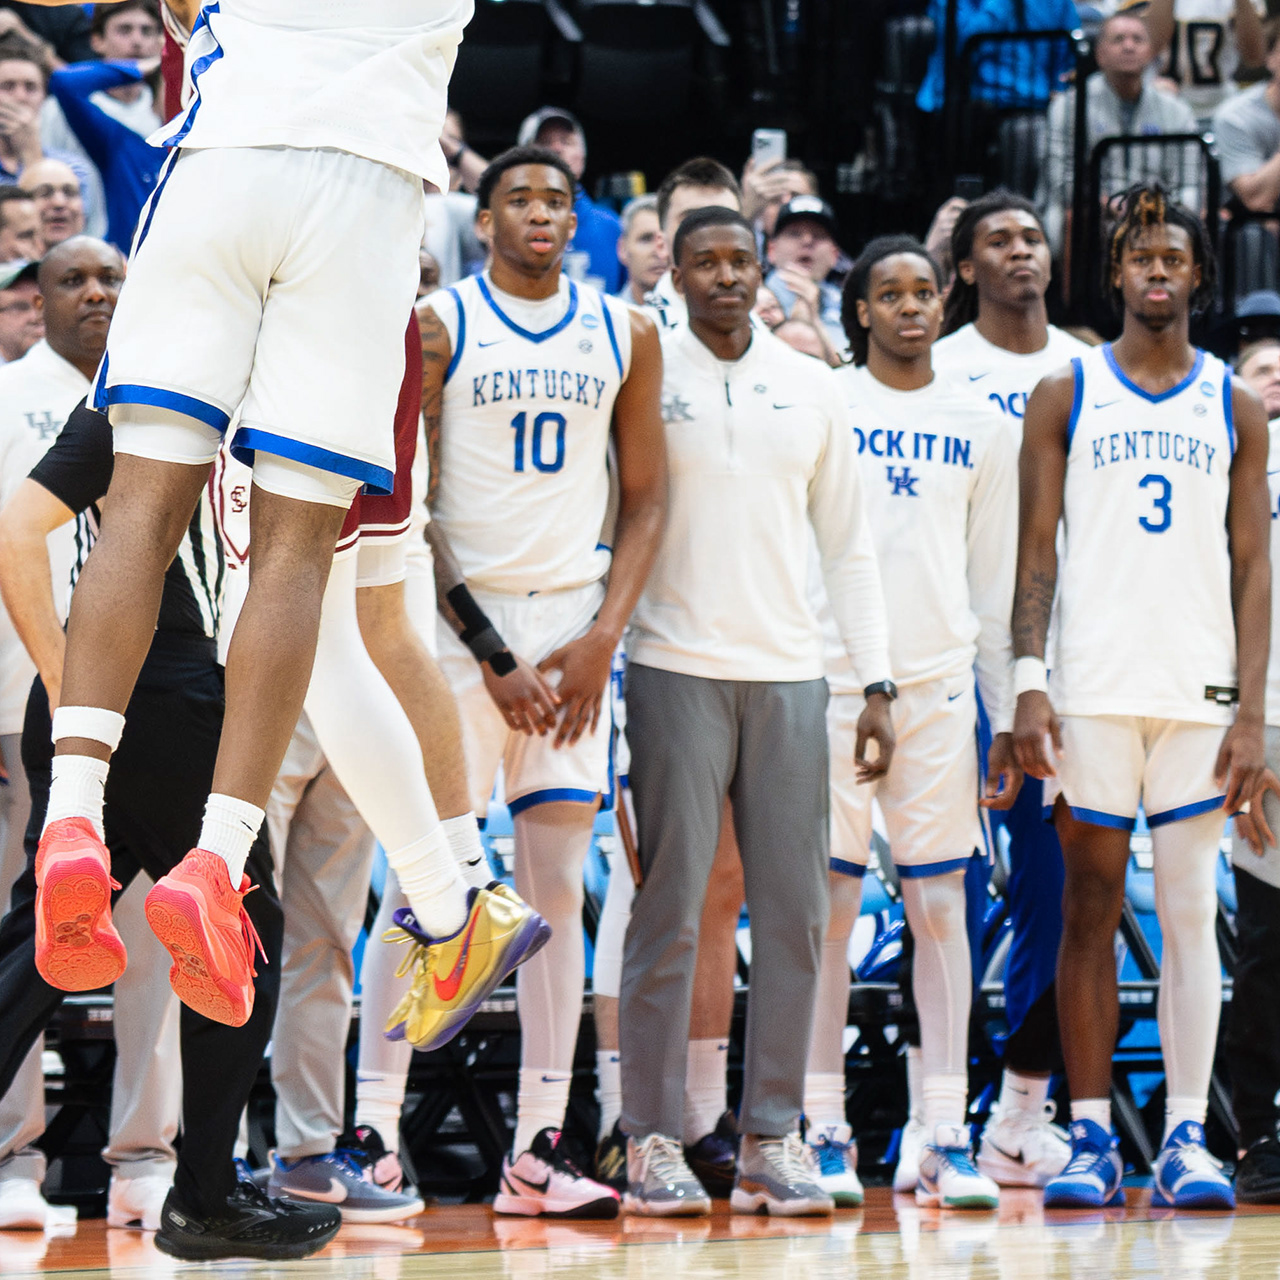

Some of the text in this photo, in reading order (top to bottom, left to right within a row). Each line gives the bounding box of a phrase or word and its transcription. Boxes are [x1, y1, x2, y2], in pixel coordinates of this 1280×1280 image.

[472, 368, 606, 410] KENTUCKY
[510, 411, 568, 475] 10
[853, 426, 974, 470] OCK IT IN.
[1091, 430, 1216, 475] KENTUCKY
[886, 465, 920, 497] UK
[1137, 473, 1173, 534] 3
